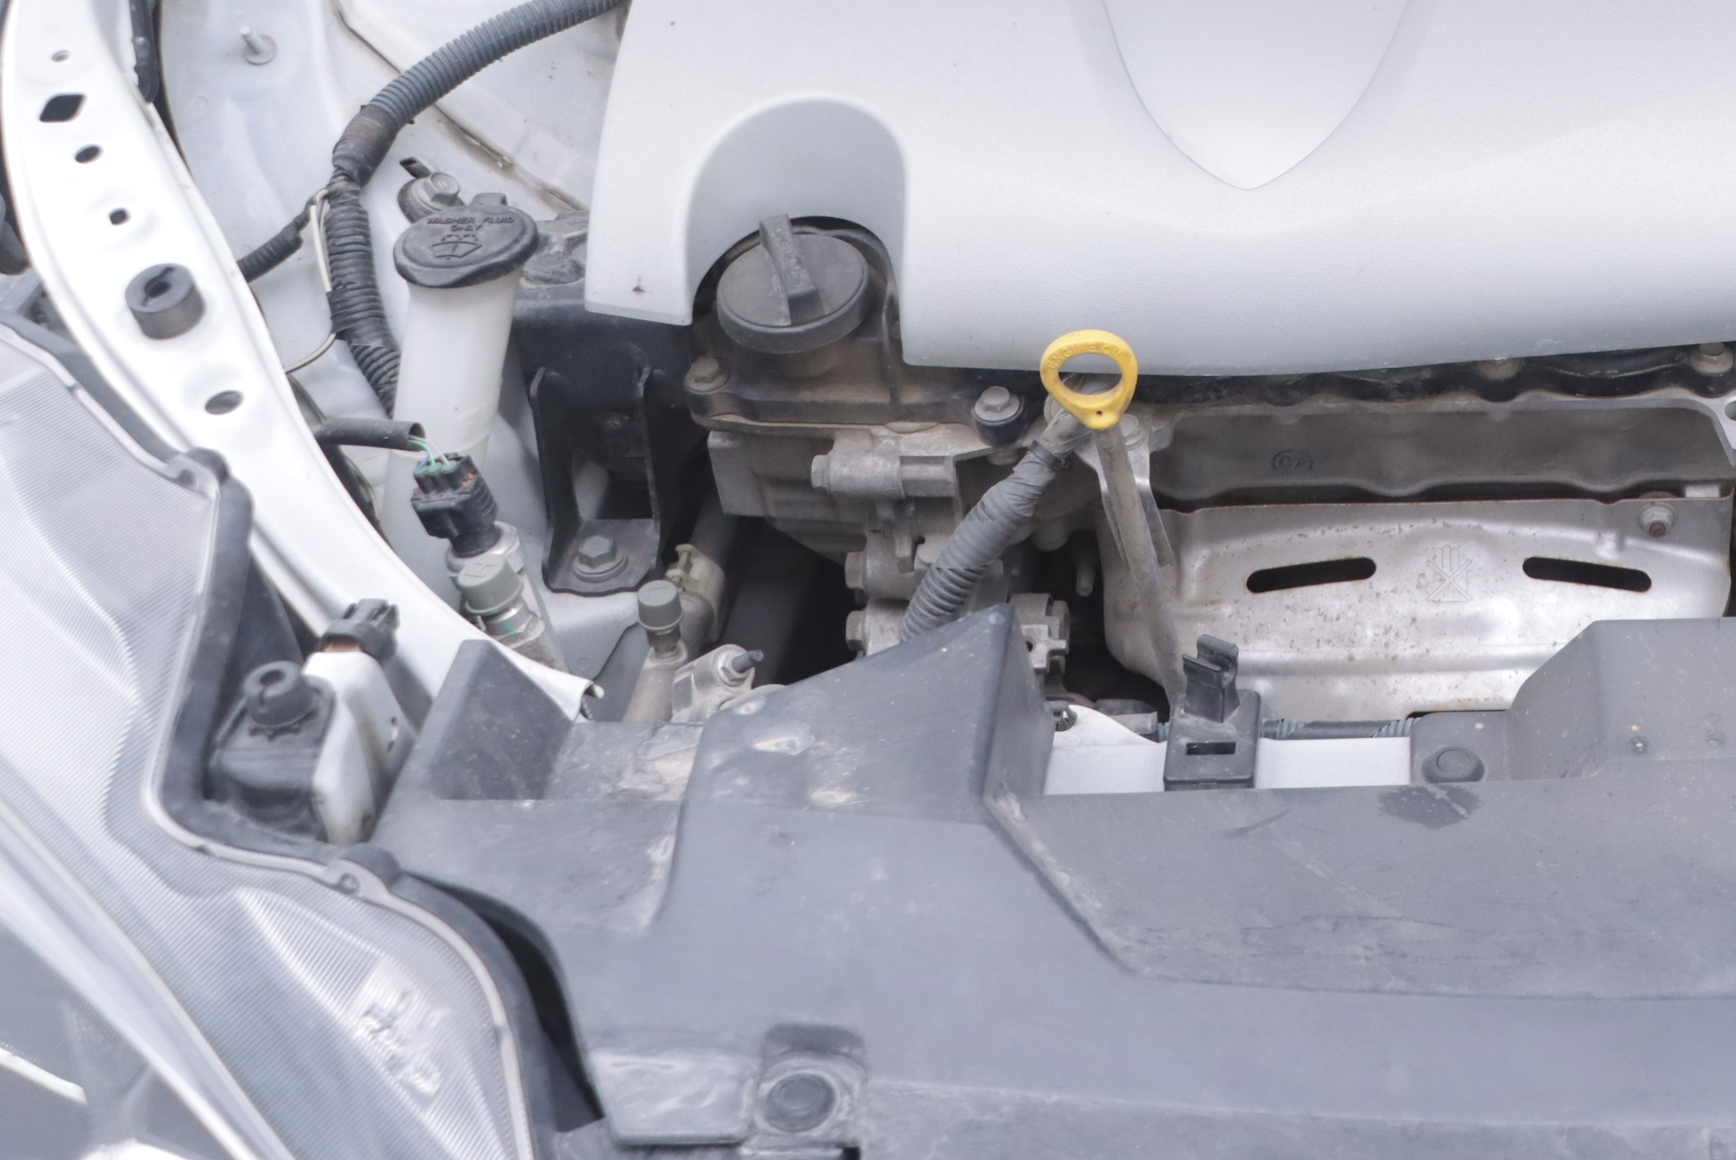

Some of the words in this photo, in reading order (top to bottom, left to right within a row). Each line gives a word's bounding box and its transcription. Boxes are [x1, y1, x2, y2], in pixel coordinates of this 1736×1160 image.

[427, 217, 476, 225] WASHER
[482, 216, 516, 224] FLUID
[450, 224, 483, 232] ONLY
[1046, 343, 1098, 370] ENGINE
